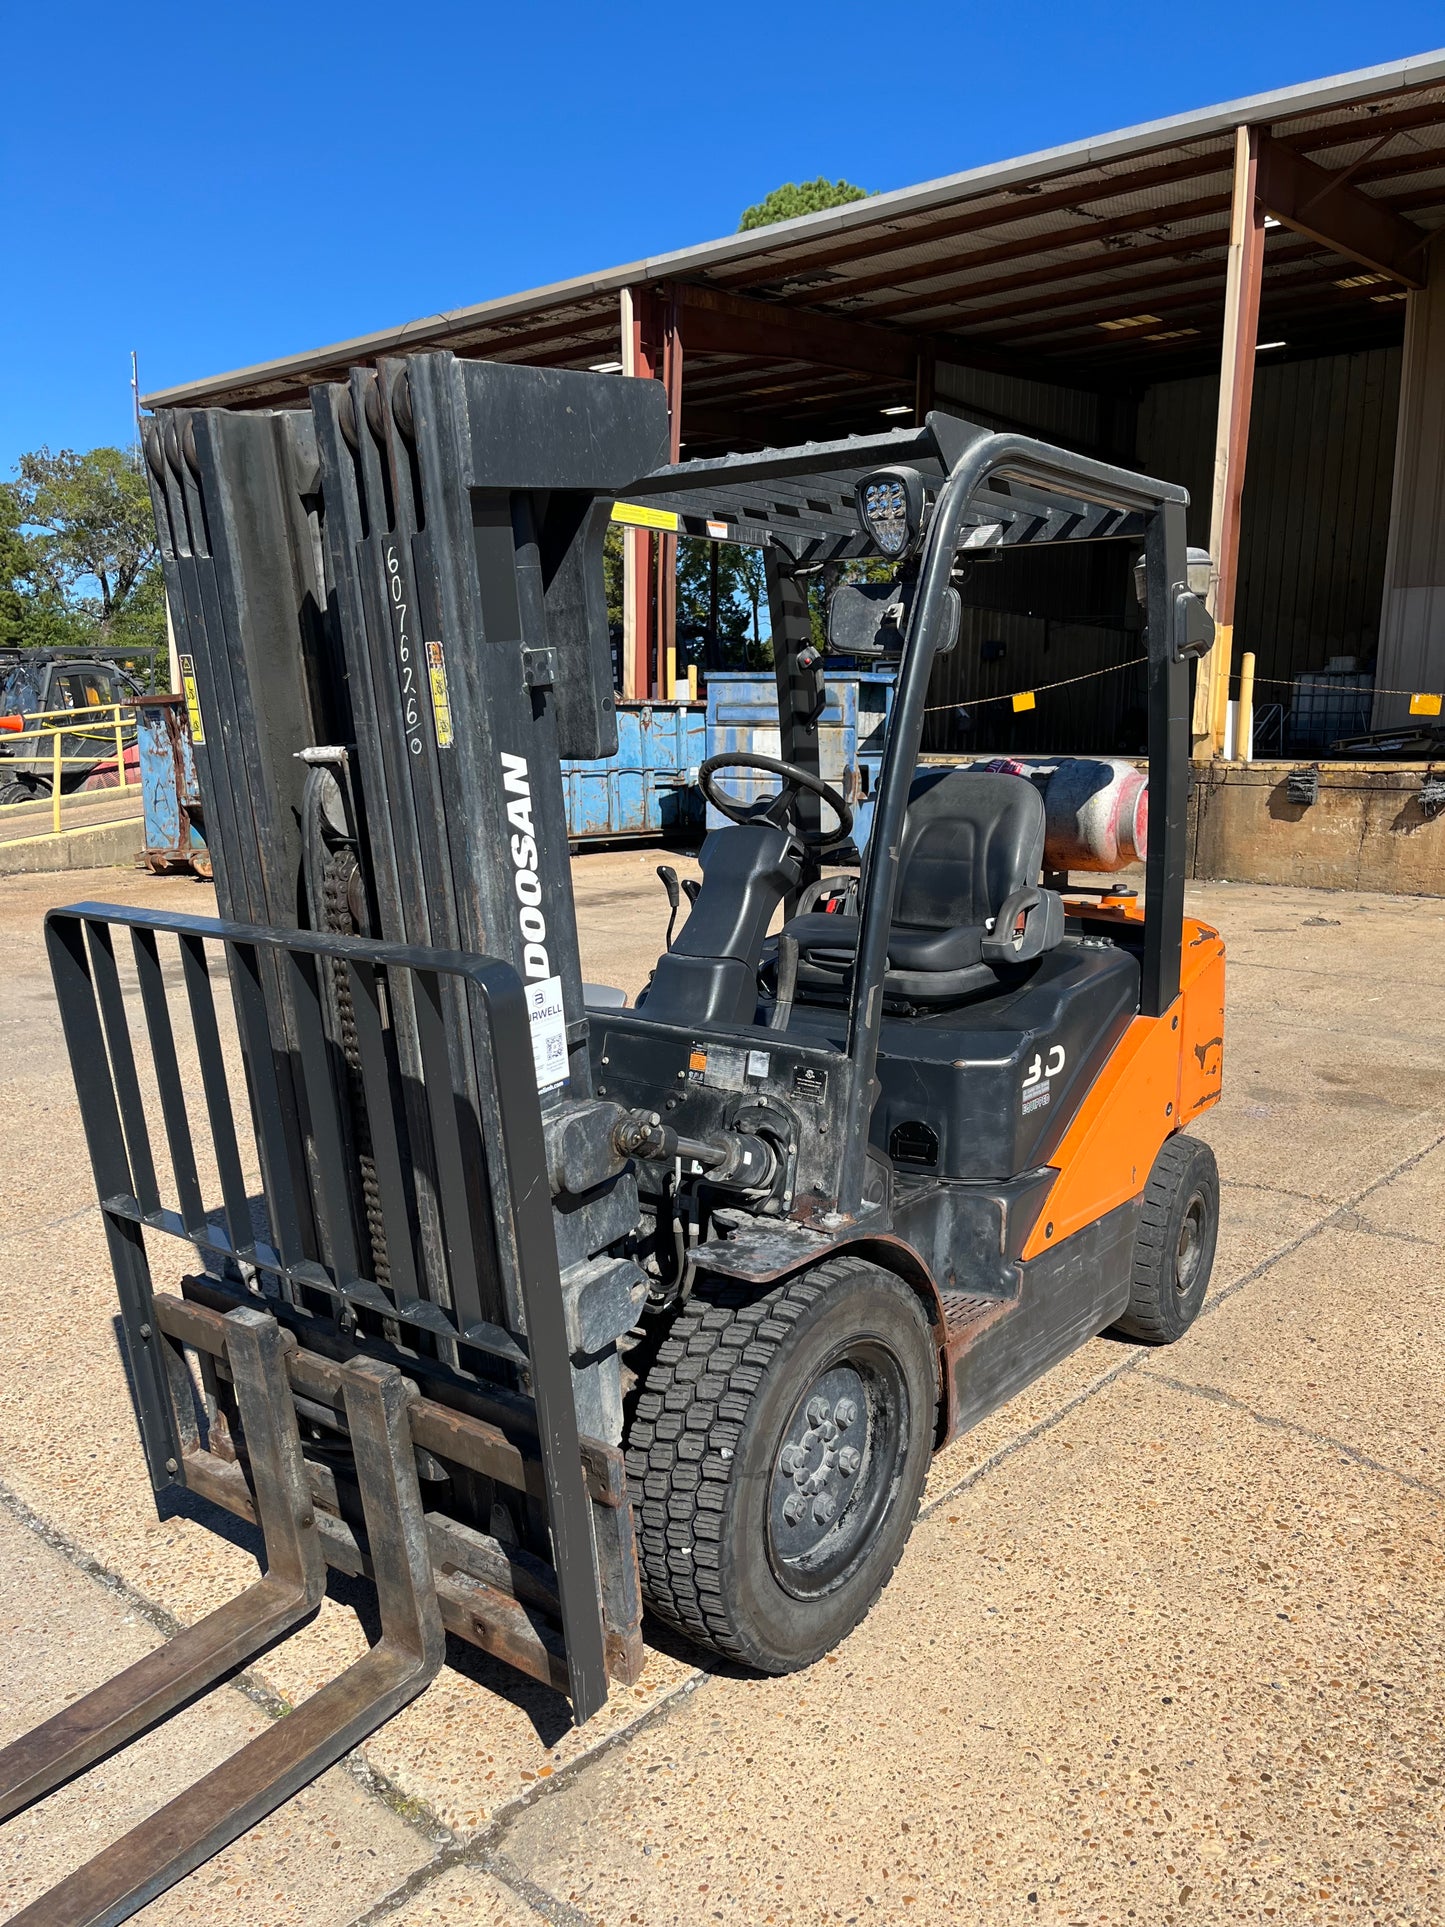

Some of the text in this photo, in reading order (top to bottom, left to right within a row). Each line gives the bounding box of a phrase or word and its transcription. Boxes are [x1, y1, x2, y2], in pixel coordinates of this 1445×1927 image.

[500, 751, 550, 979] DOOSAN
[529, 1003, 563, 1022] RWELL
[1021, 1044, 1066, 1088] 30
